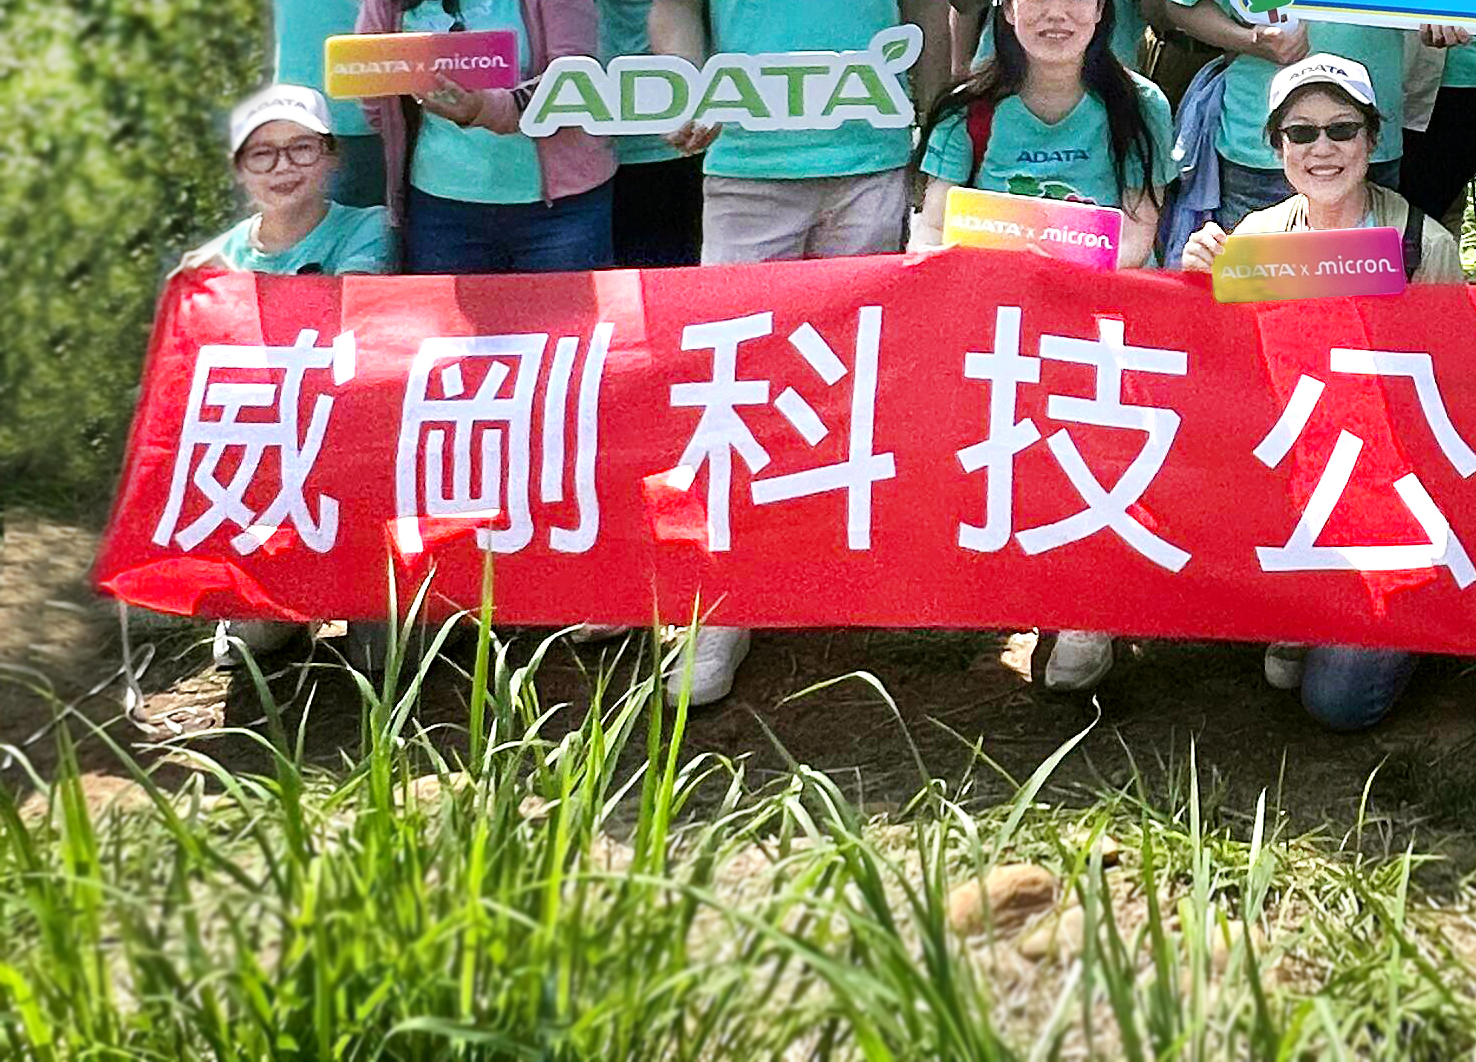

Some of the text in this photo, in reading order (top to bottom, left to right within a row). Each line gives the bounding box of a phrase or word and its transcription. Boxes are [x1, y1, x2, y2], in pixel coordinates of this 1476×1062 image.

[333, 59, 410, 76] ADATA
[428, 53, 509, 72] micron
[533, 64, 901, 124] ADATA
[1017, 149, 1089, 163] ADATA
[952, 214, 1022, 237] ADATA
[1039, 225, 1114, 249] micron
[1220, 263, 1296, 279] ADATA
[1314, 255, 1397, 275] micron
